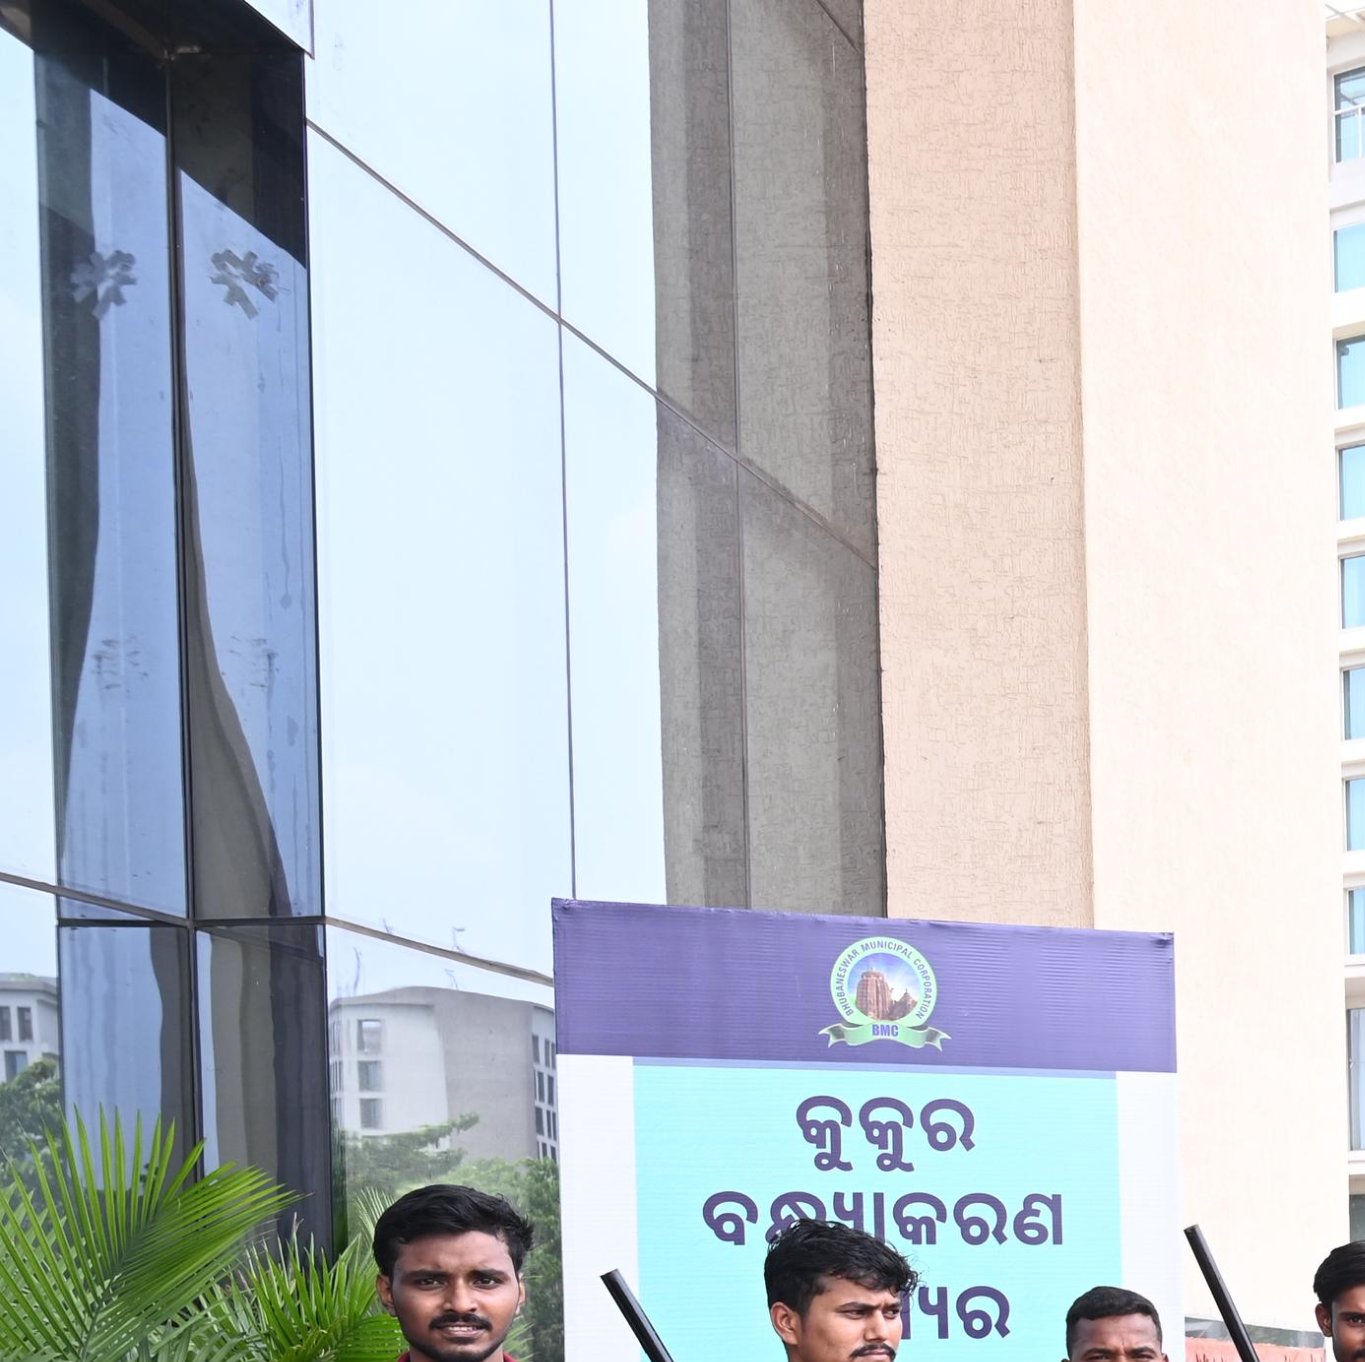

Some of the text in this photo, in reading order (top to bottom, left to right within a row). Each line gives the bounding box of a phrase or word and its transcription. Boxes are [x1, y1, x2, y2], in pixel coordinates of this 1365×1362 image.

[835, 940, 933, 1020] BHUBANESWAR MUNICIPAL CORPORATION
[871, 1023, 899, 1037] BMC
[795, 1094, 977, 1173] କୁକୁର
